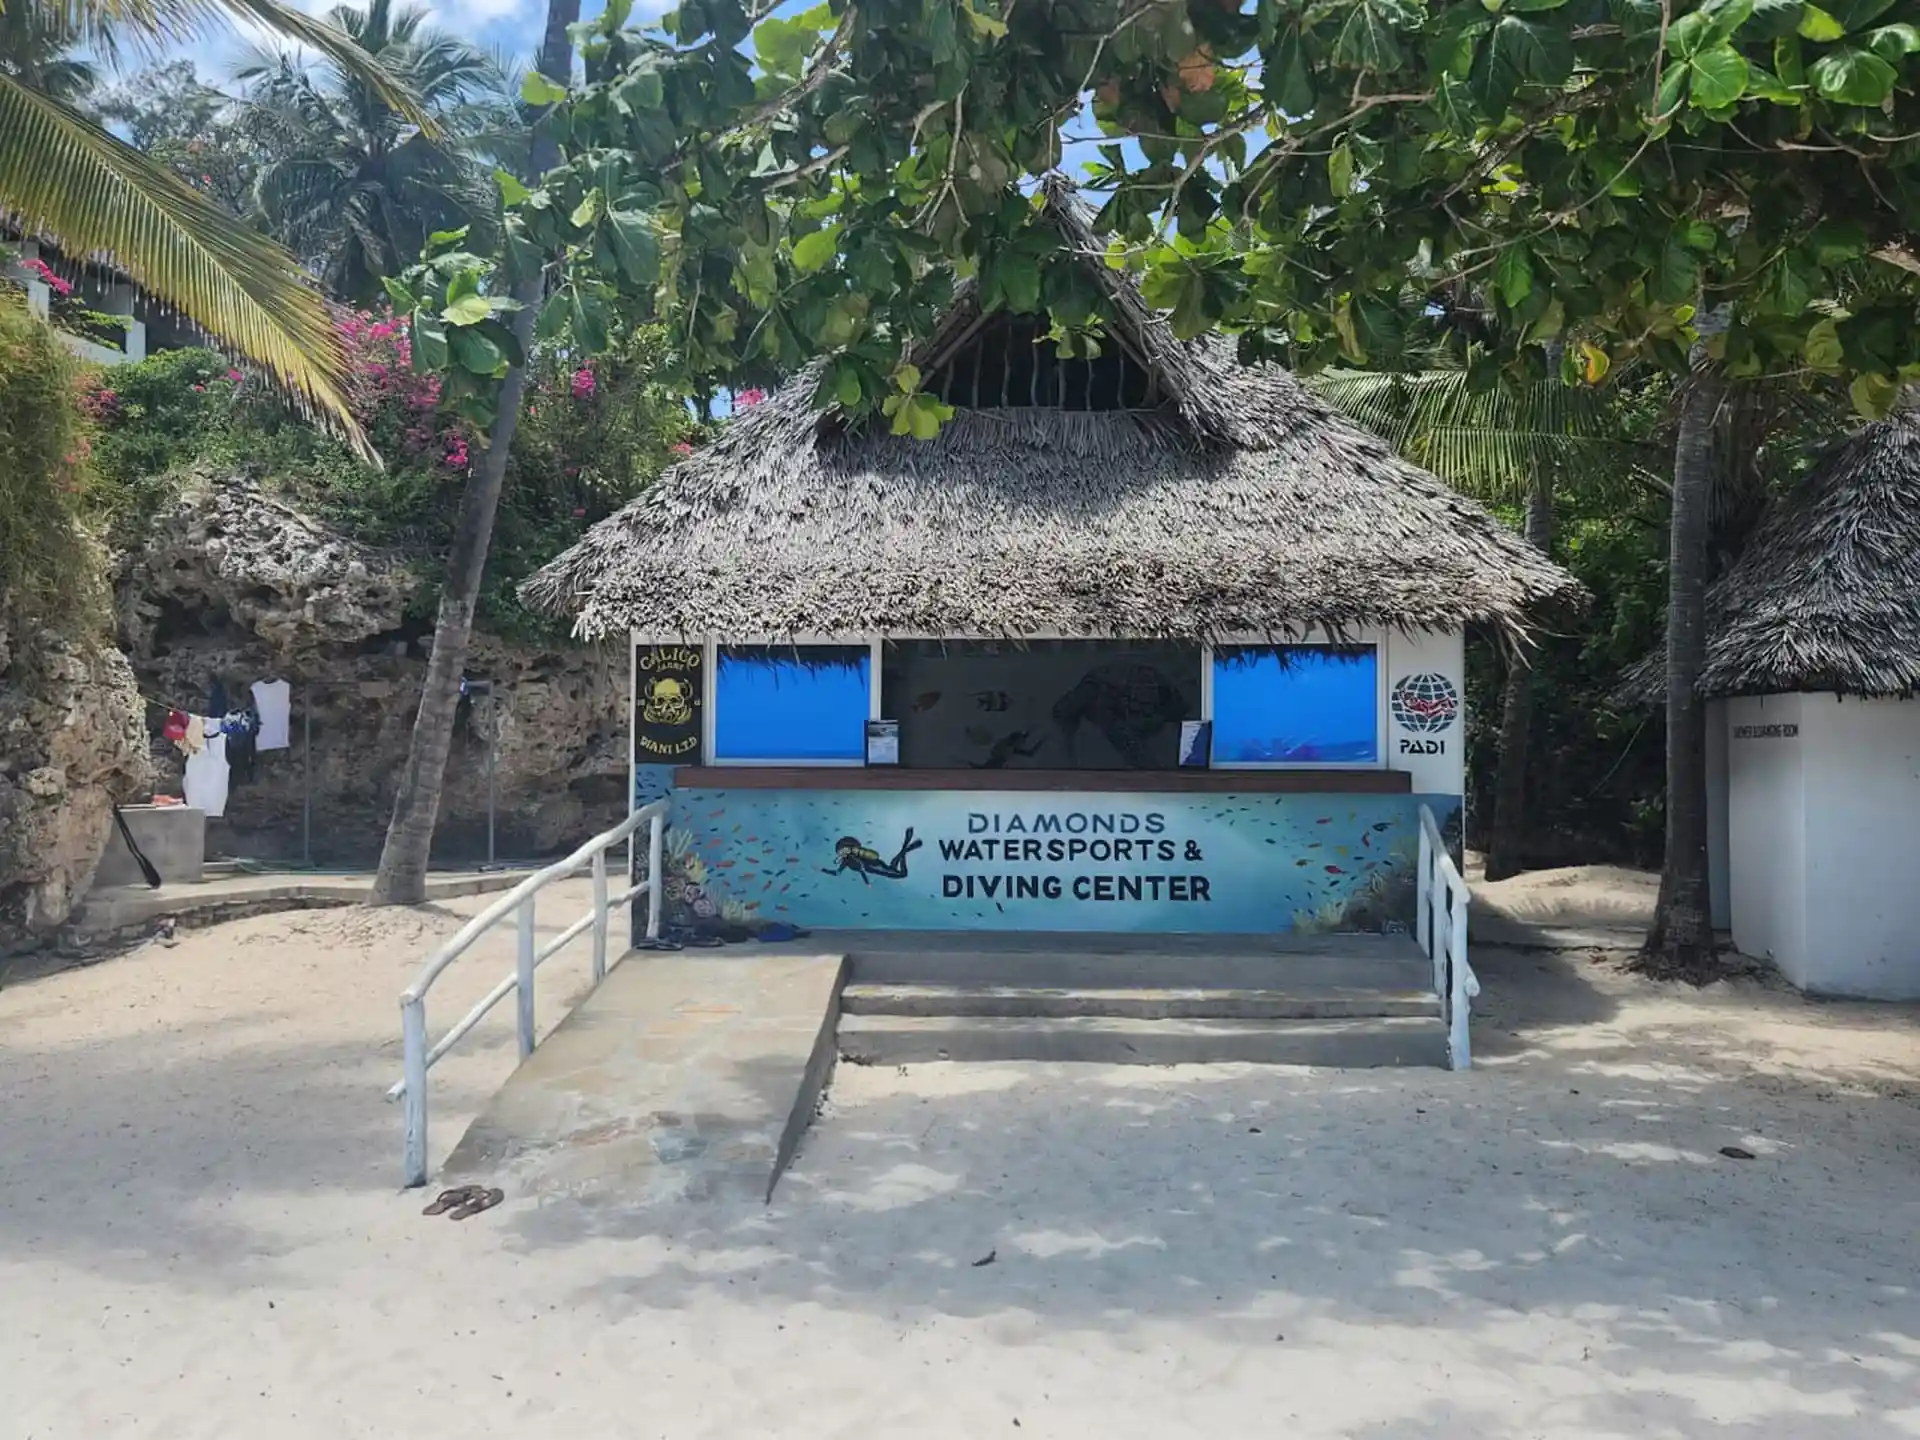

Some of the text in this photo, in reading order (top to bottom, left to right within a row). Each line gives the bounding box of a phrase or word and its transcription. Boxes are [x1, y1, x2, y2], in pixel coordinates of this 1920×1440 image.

[640, 647, 701, 670] CALICO
[640, 735, 698, 755] DIANI LTD
[1400, 739, 1445, 755] PADI
[968, 812, 1166, 834] DIAMONDS
[938, 839, 1204, 862] WATERSPORTS &
[942, 875, 1212, 901] DIVING CENTER
